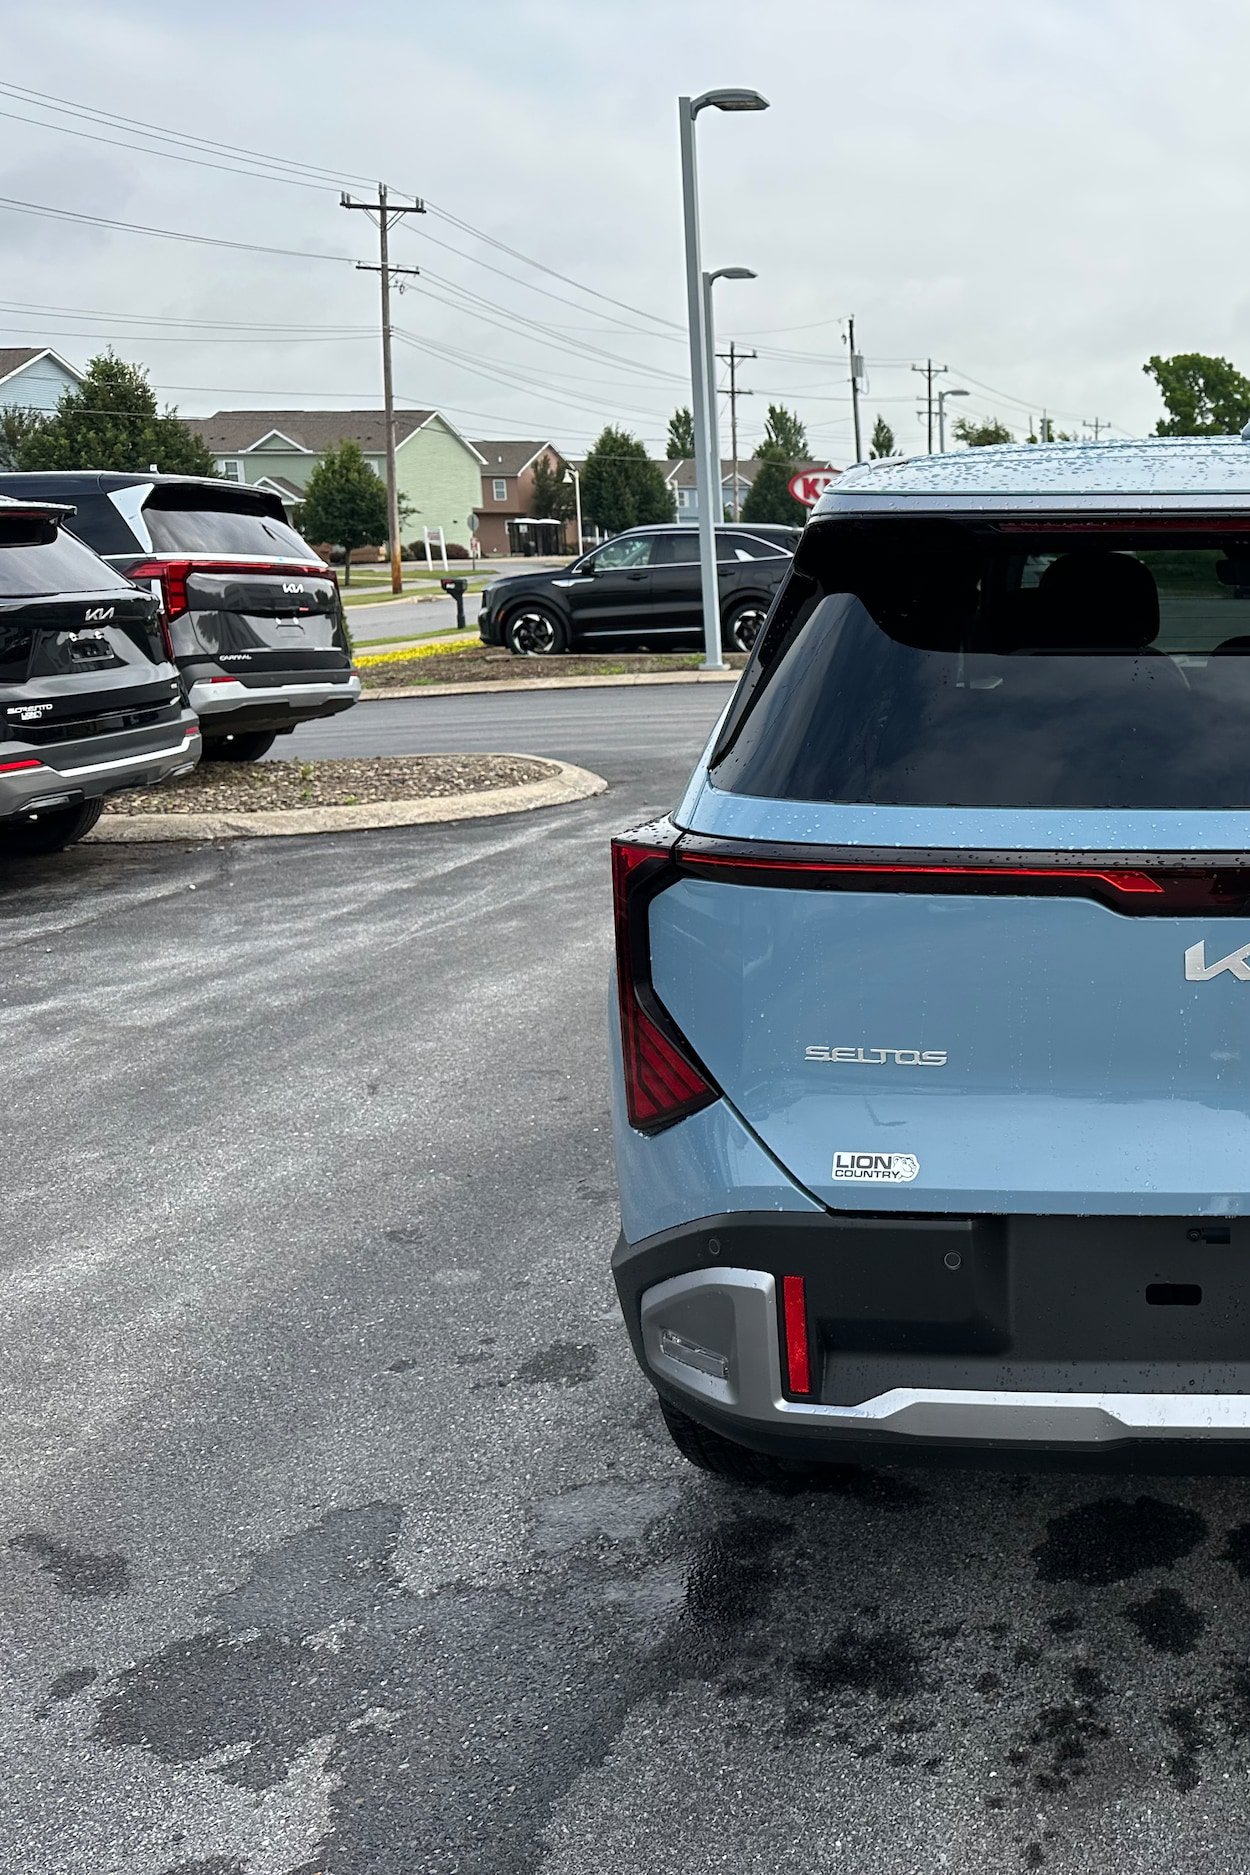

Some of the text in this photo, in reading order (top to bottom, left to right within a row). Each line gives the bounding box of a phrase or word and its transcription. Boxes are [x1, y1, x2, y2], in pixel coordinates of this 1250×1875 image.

[282, 583, 304, 593] KIA
[85, 606, 115, 621] KIA
[804, 1045, 949, 1067] SELTOS
[836, 1154, 892, 1169] LION
[834, 1169, 901, 1179] COUNTRY
